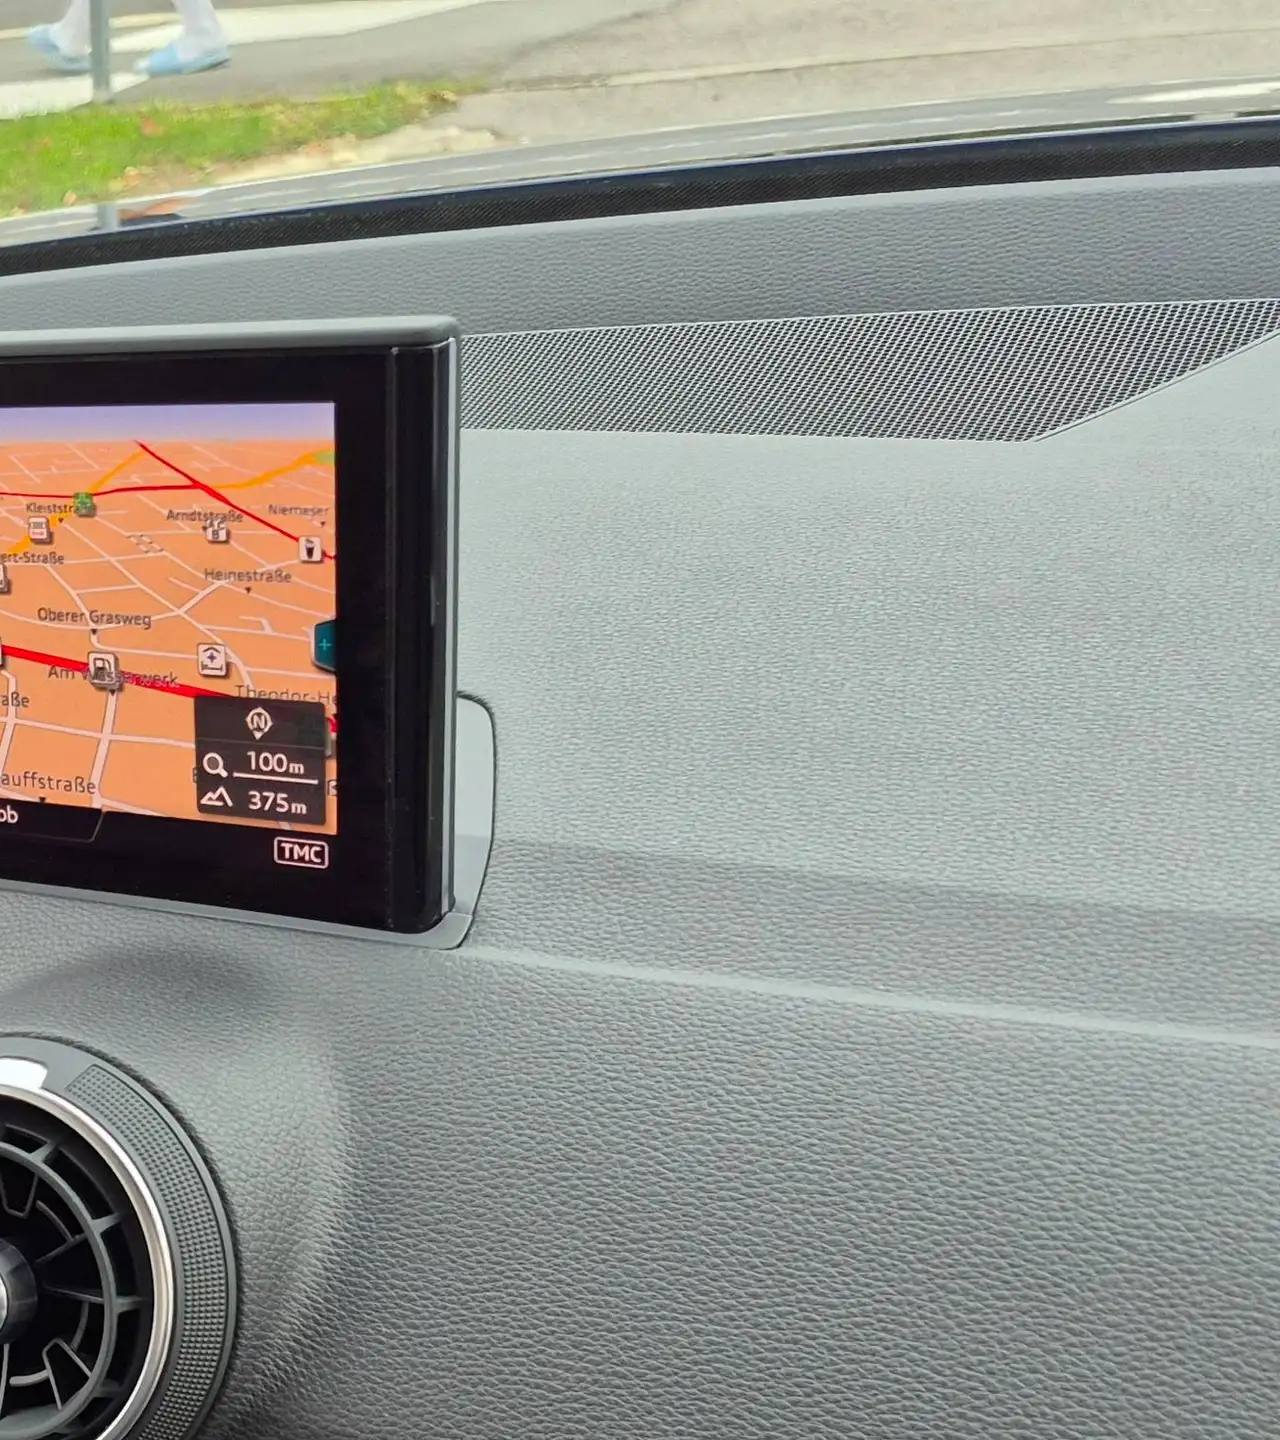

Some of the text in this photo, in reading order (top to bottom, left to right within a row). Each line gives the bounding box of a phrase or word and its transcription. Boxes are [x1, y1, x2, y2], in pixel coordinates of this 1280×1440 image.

[166, 509, 243, 523] Arndtstraße
[205, 568, 292, 583] Heinestraße
[37, 608, 151, 630] Oberer Grasweg
[48, 664, 179, 684] Am Wsserwerk
[280, 842, 323, 864] TMC
